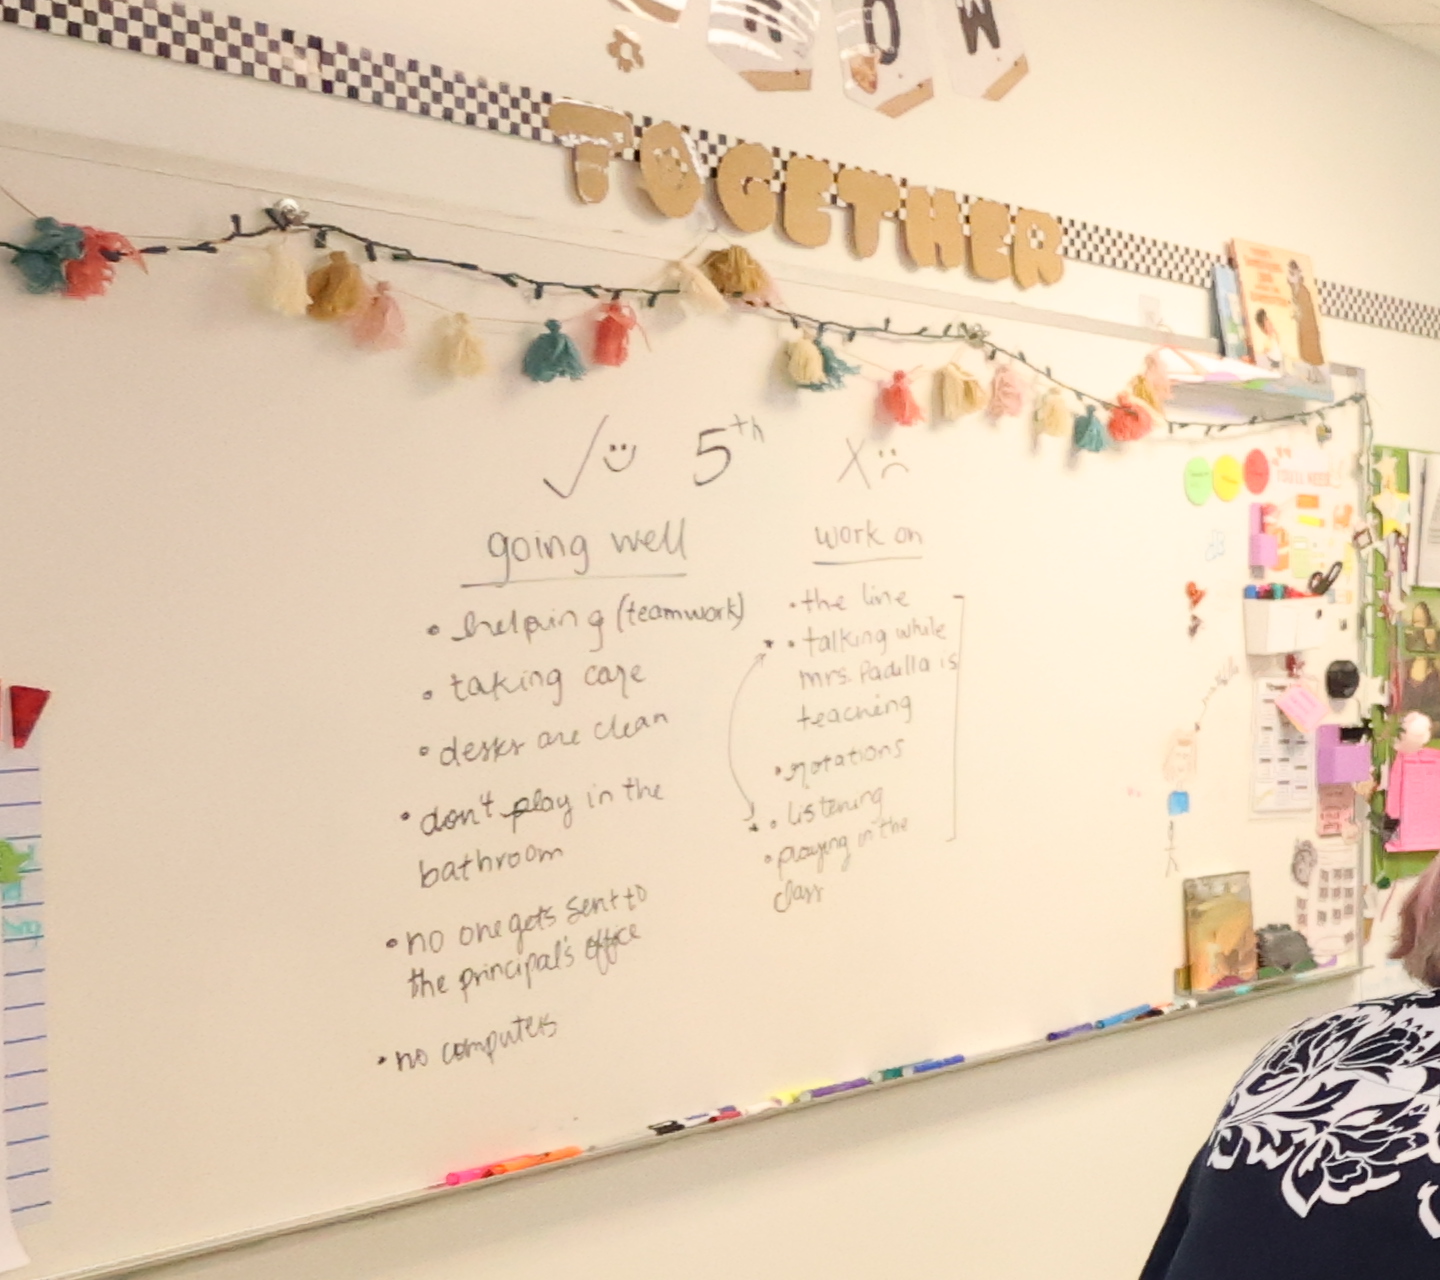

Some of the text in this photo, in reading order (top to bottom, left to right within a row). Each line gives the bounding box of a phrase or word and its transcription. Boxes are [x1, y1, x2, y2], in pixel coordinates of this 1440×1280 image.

[548, 99, 1065, 290] TOGETHER
[488, 519, 687, 587] going well
[814, 518, 925, 549] work on
[451, 592, 745, 653] helping (teamwork)
[801, 587, 847, 614] the
[802, 616, 947, 657] talking while
[939, 652, 960, 672] is
[450, 664, 648, 707] taking care
[796, 693, 914, 732] teaching
[438, 710, 671, 768] desks are clean
[500, 787, 575, 834] play
[586, 783, 614, 810] in
[622, 777, 666, 802] the
[418, 844, 565, 890] bathroom
[777, 835, 852, 882] playing
[405, 883, 648, 956] no one gets sent to
[407, 922, 643, 1005] the principal's office
[394, 1012, 559, 1073] no computers
